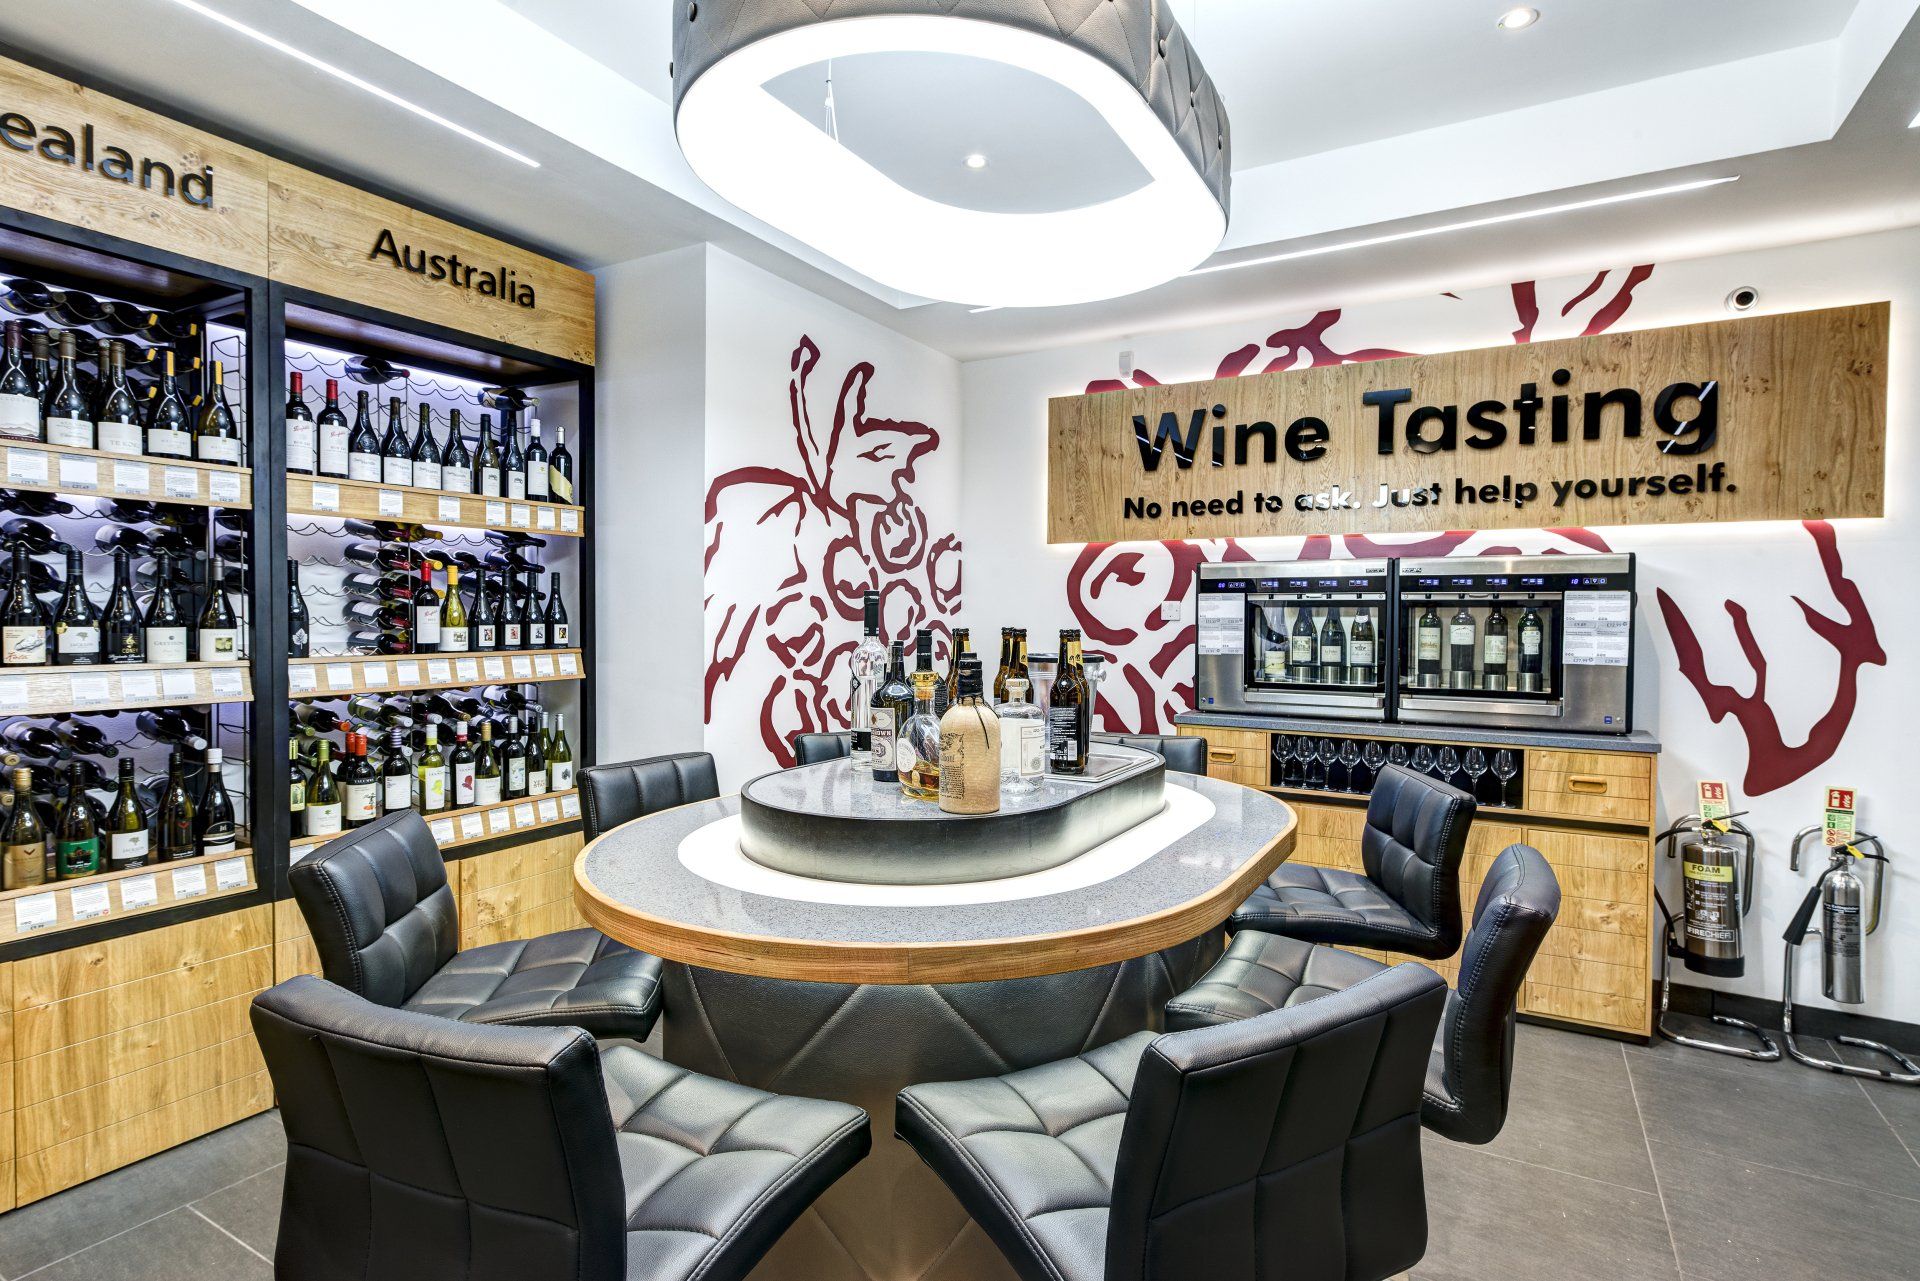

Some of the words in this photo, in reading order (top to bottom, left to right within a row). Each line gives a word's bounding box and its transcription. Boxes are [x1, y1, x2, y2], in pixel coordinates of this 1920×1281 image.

[370, 229, 535, 308] Australia
[1132, 403, 1330, 472] Wine
[1363, 368, 1719, 455] Tasting
[1123, 497, 1162, 519] No
[1172, 490, 1244, 517] need
[1254, 492, 1283, 513] to
[1294, 484, 1361, 511] ask.
[1371, 482, 1442, 508] Just
[1455, 475, 1538, 508] help
[1551, 462, 1737, 507] yourself.
[1691, 864, 1721, 874] FOAM
[1687, 926, 1732, 939] FIRECHIEF
